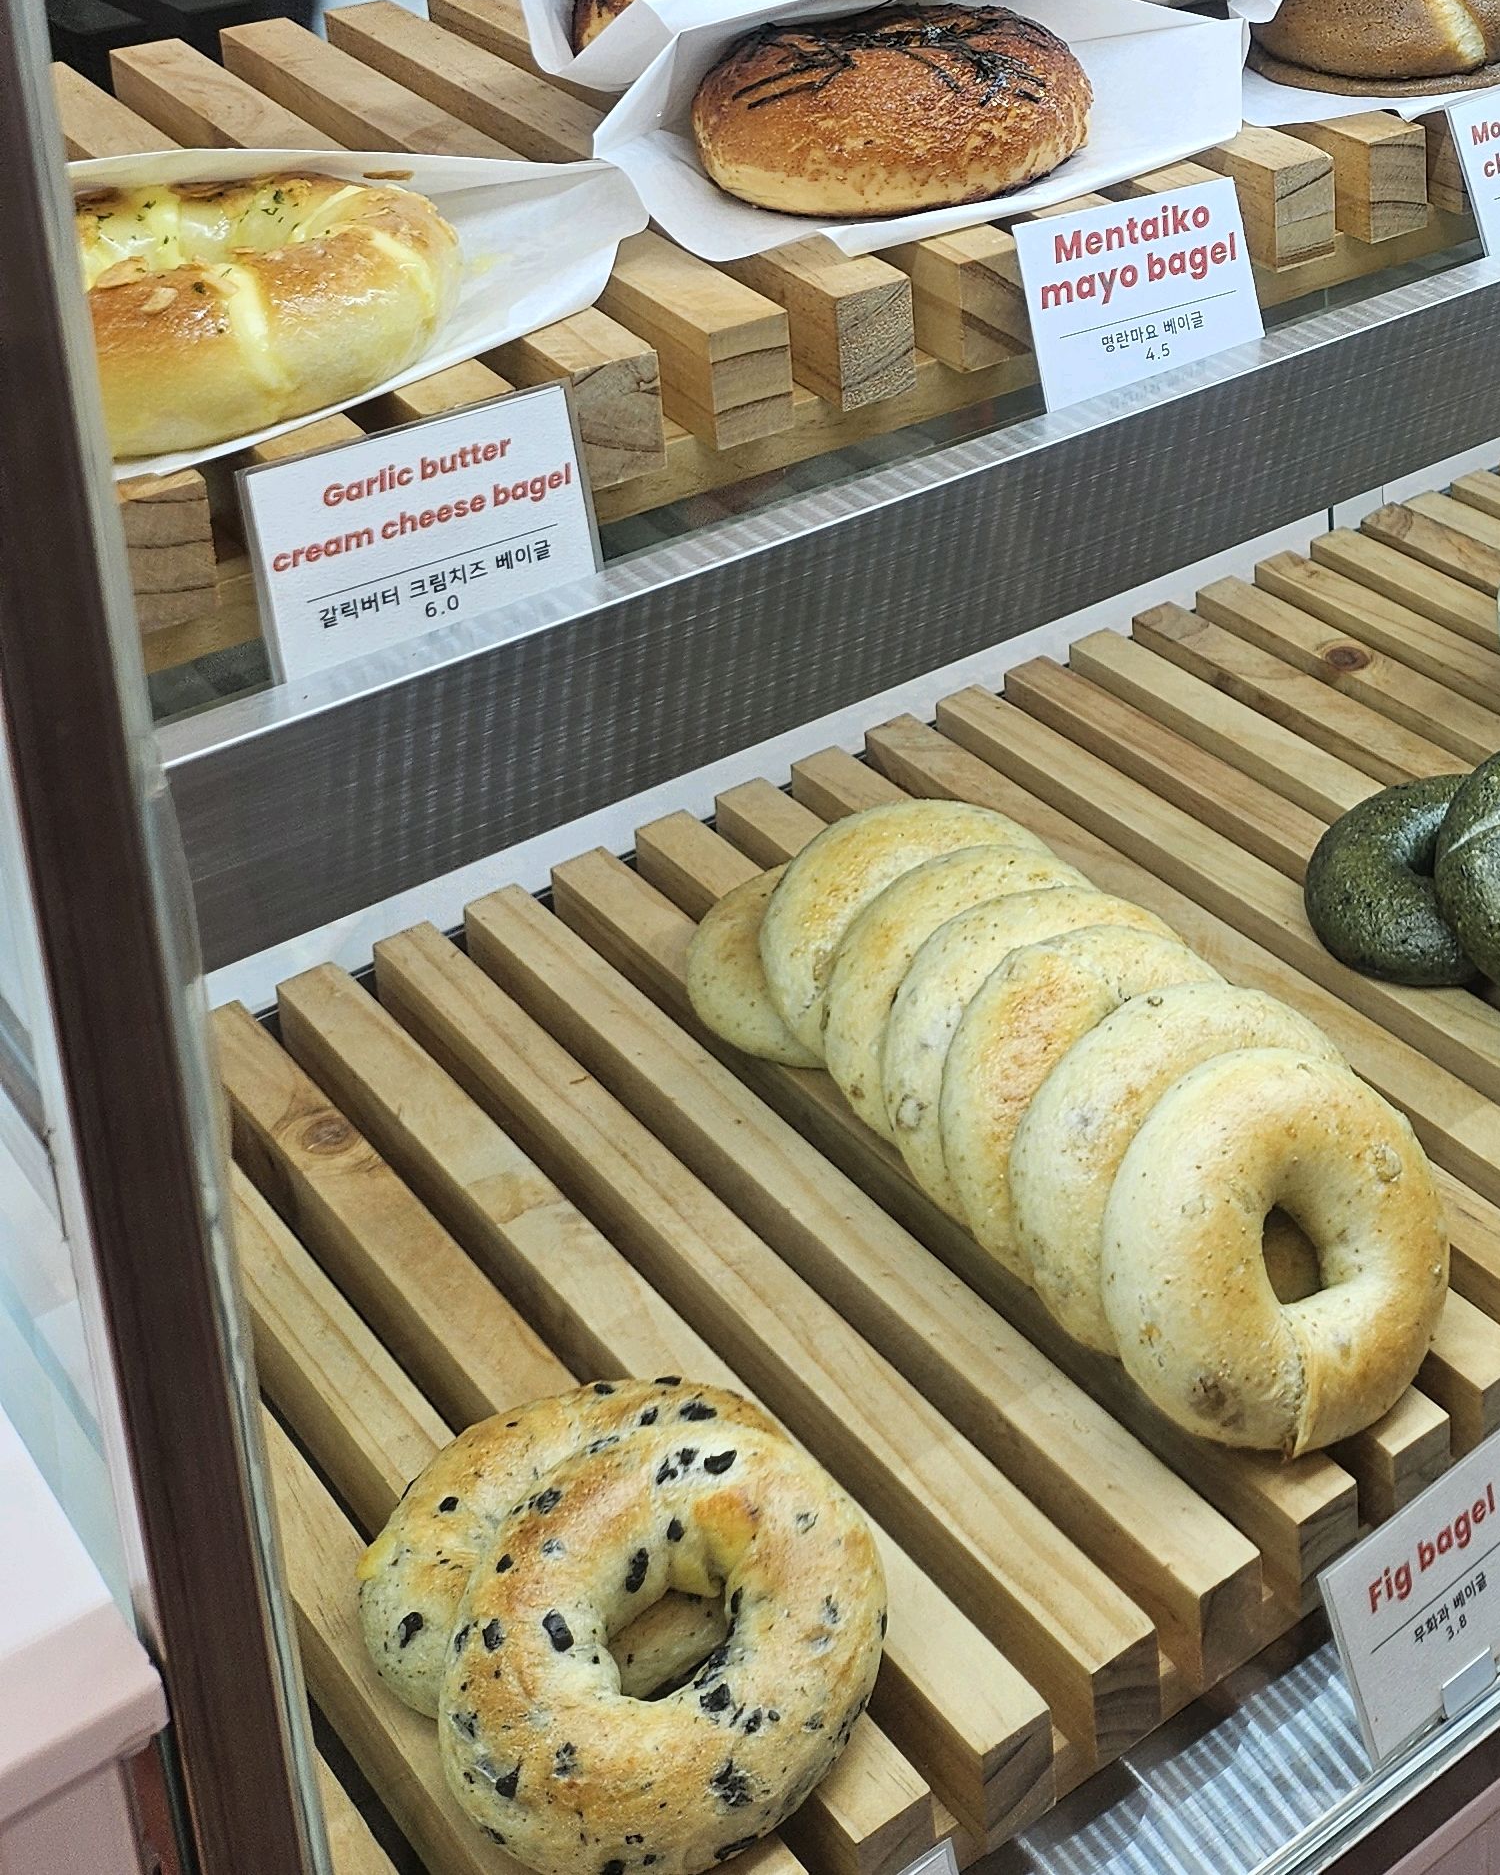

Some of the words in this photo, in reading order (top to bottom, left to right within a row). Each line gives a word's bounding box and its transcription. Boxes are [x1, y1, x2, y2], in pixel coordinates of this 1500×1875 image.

[1054, 204, 1210, 264] Mentaiko
[1041, 263, 1138, 310] mayo
[1147, 232, 1237, 282] bagel
[1101, 324, 1158, 353] 명란마요
[1163, 310, 1205, 335] 베이글
[1145, 343, 1170, 361] 4.5
[323, 463, 414, 507] Garlic
[420, 437, 511, 482] butter
[273, 526, 374, 572] cream
[381, 492, 487, 540] cheese
[492, 462, 573, 507] bagel
[319, 586, 401, 629] 갈릭버터
[409, 561, 488, 599] 크림치즈
[495, 539, 552, 571] 베이글
[424, 594, 460, 618] 6.0
[1367, 1560, 1413, 1614] Fig
[1417, 1481, 1496, 1572] bagel
[1414, 1603, 1450, 1644] 무화과
[1452, 1571, 1488, 1607] 베이글
[1447, 1614, 1468, 1641] 3.8
